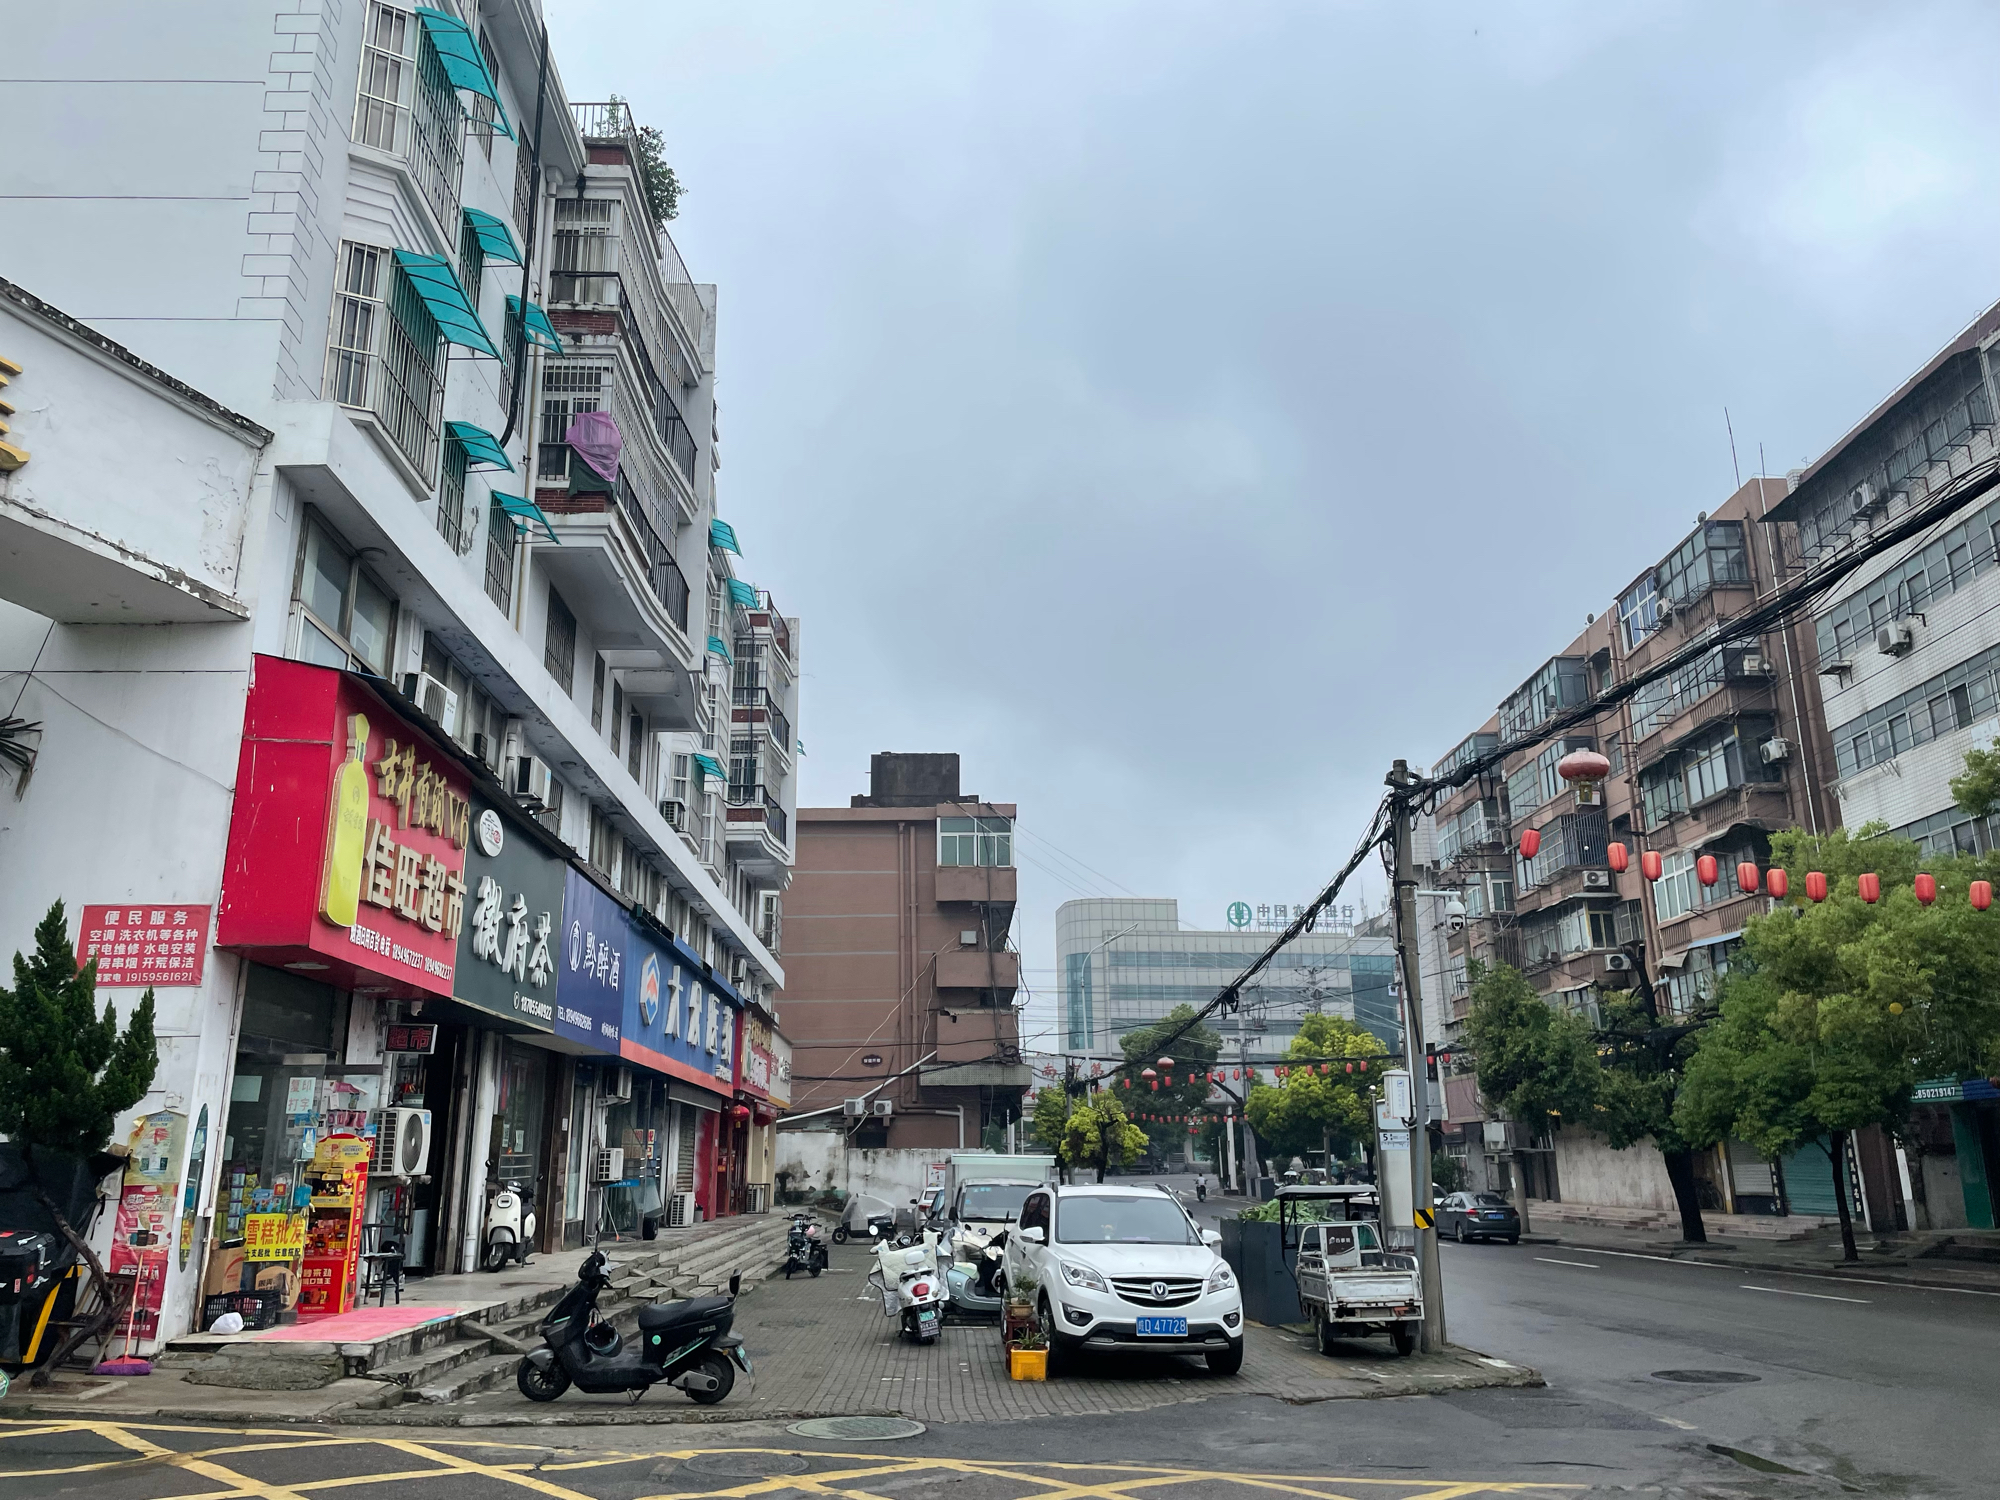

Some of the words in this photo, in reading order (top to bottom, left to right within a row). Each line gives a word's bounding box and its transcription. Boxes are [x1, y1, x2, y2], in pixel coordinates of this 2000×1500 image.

[363, 818, 466, 940] 佳旺超市
[89, 929, 115, 942] 空调
[118, 929, 198, 941] 洗衣机等各种
[87, 943, 139, 956] 家电维修
[144, 943, 196, 955] 水电安装
[87, 957, 138, 969] 房串烟
[142, 957, 194, 969] 开荒保洁
[583, 932, 621, 992] 黔醉酒
[126, 972, 192, 982] 19159561621
[388, 1027, 432, 1049] 超市
[1911, 1087, 1956, 1099] 850219147
[287, 1097, 310, 1111] 打字
[246, 1219, 304, 1245] 雪糕批发
[275, 1248, 301, 1257] 任意搭配
